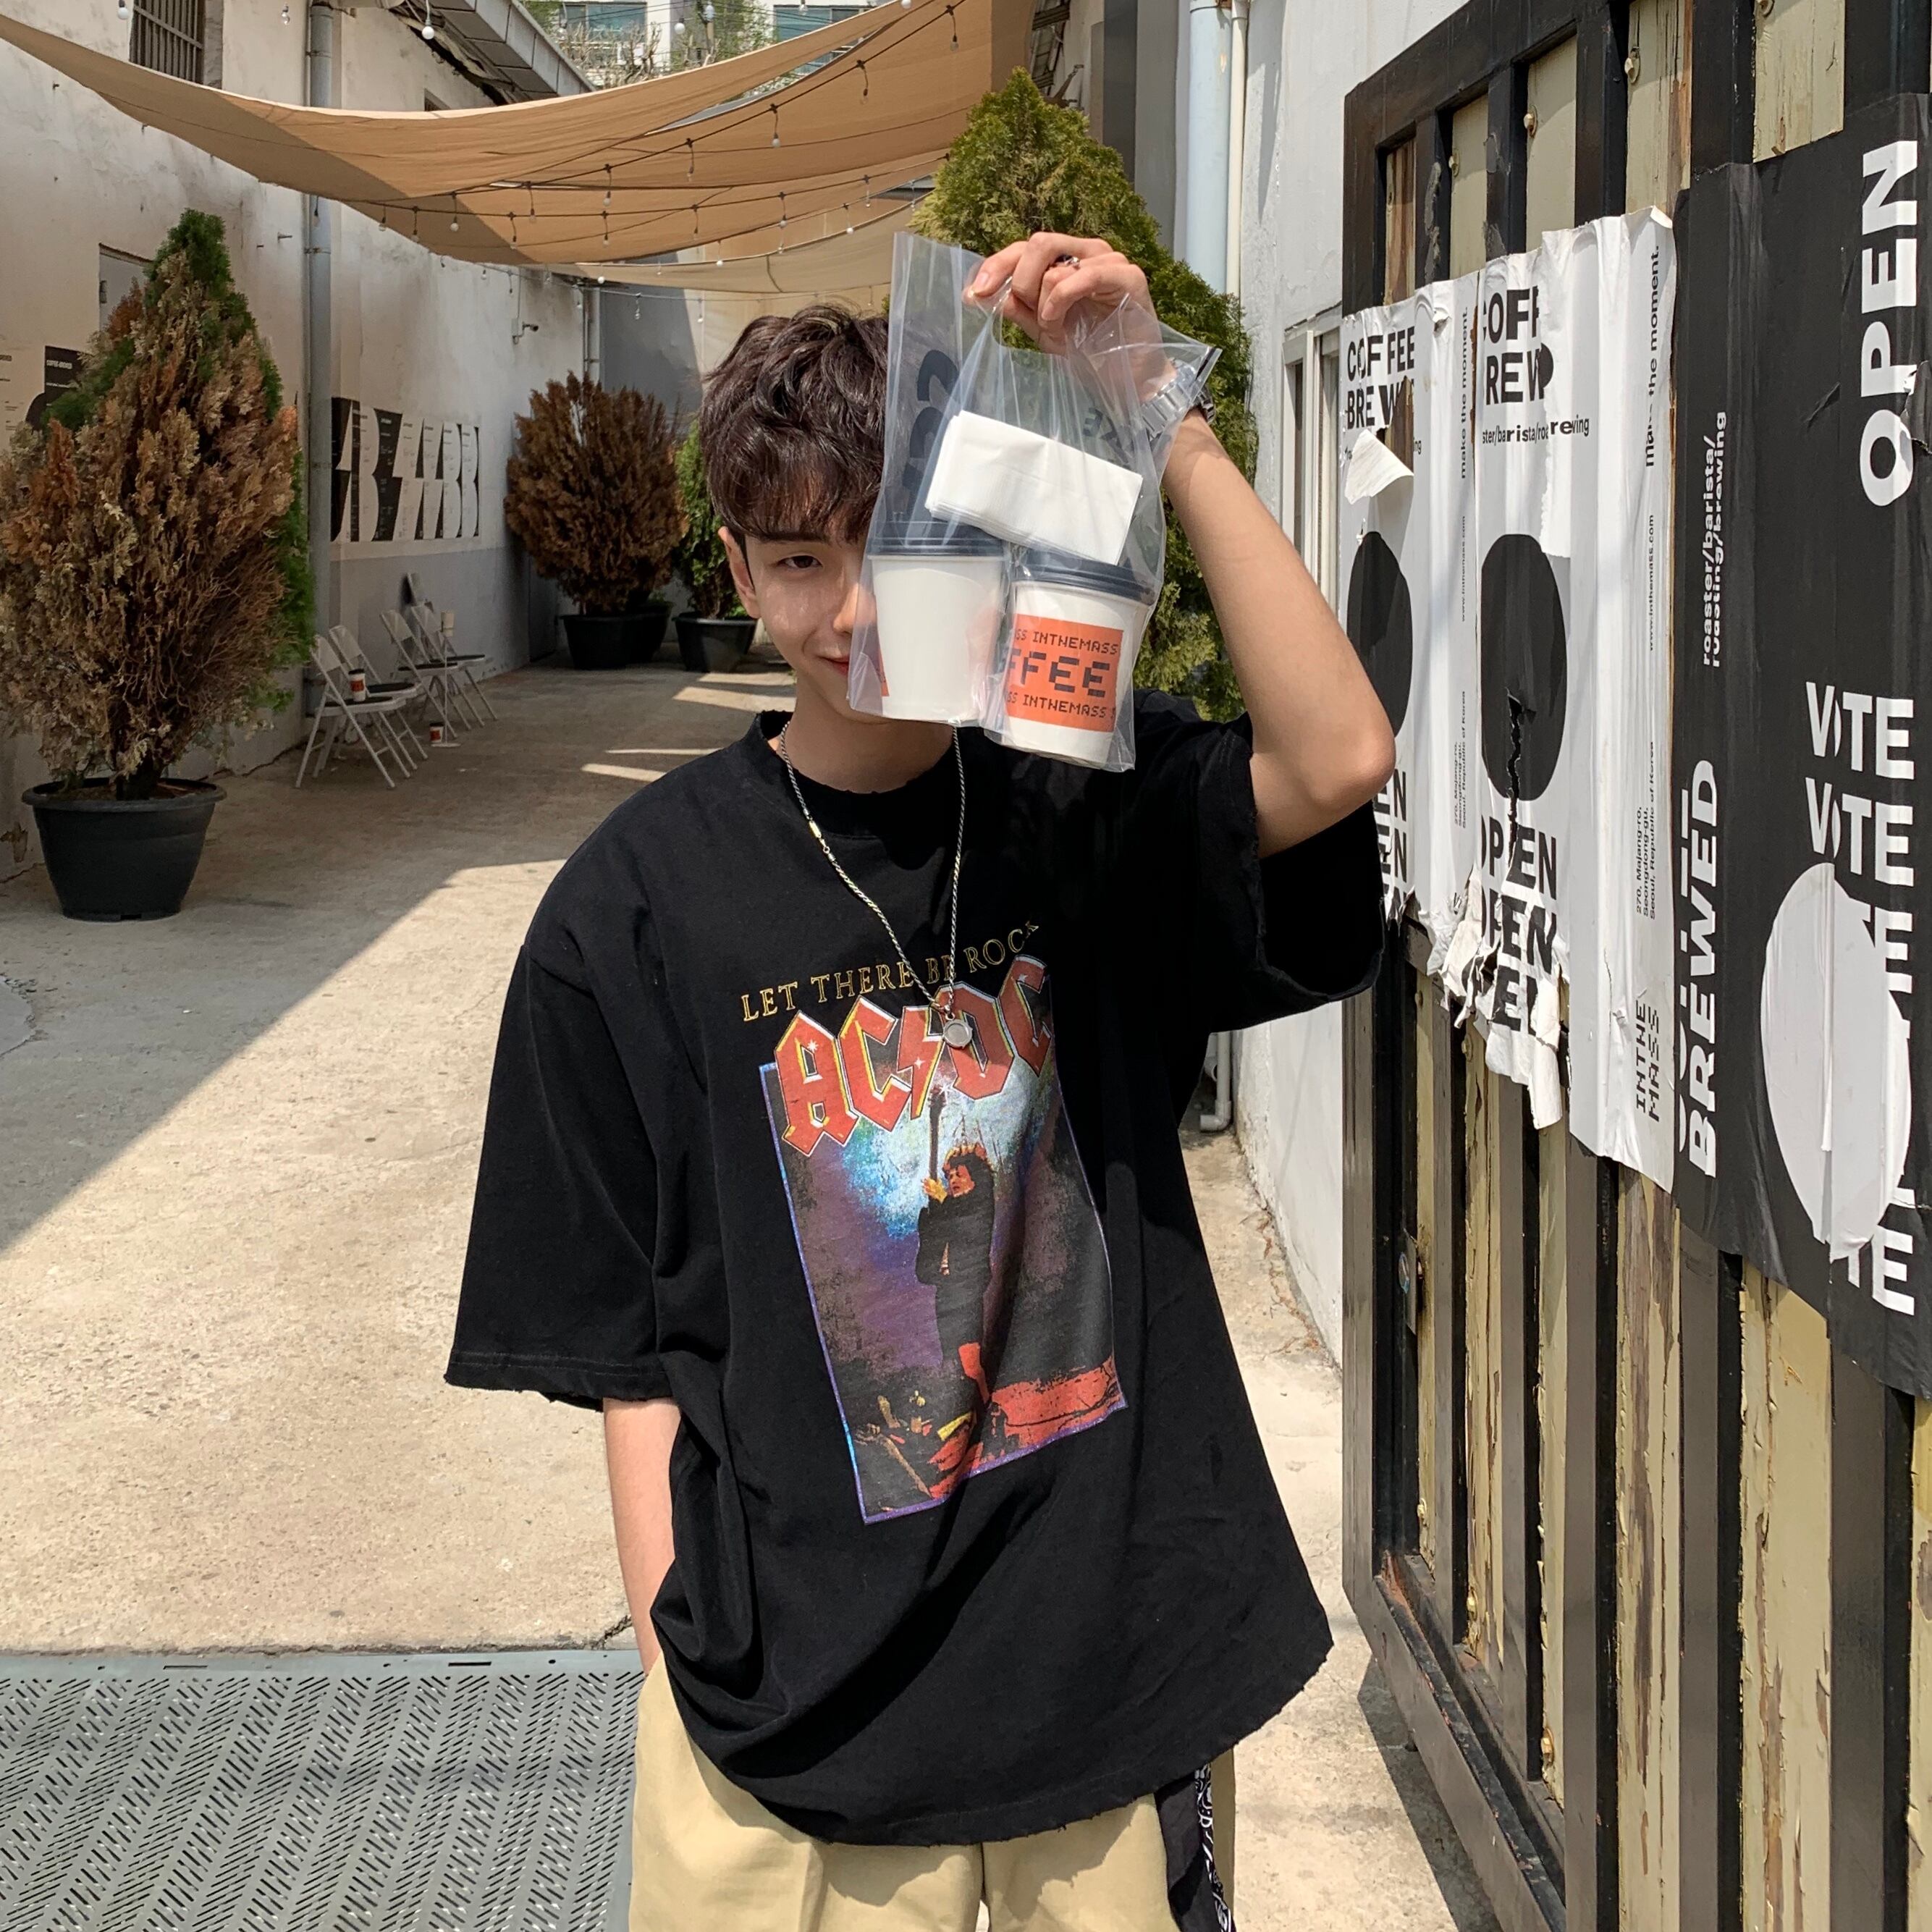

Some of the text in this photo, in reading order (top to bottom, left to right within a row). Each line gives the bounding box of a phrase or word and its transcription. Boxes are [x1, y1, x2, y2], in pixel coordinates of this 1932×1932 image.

[1650, 245, 1659, 351] moment.
[1860, 140, 1918, 507] OPEN
[1347, 326, 1415, 382] COFFEE
[1648, 357, 1657, 397] the
[1702, 434, 1716, 665] roaster/barista/
[1805, 681, 1915, 780] VTE
[1649, 787, 1654, 802] of
[1805, 777, 1914, 887] VTE
[741, 981, 799, 1022] LET
[810, 961, 914, 1004] THERE
[925, 953, 957, 985] BE
[1689, 759, 1717, 1178] BREWED
[1636, 998, 1646, 1113] INTHE
[1648, 1005, 1660, 1122] MASS
